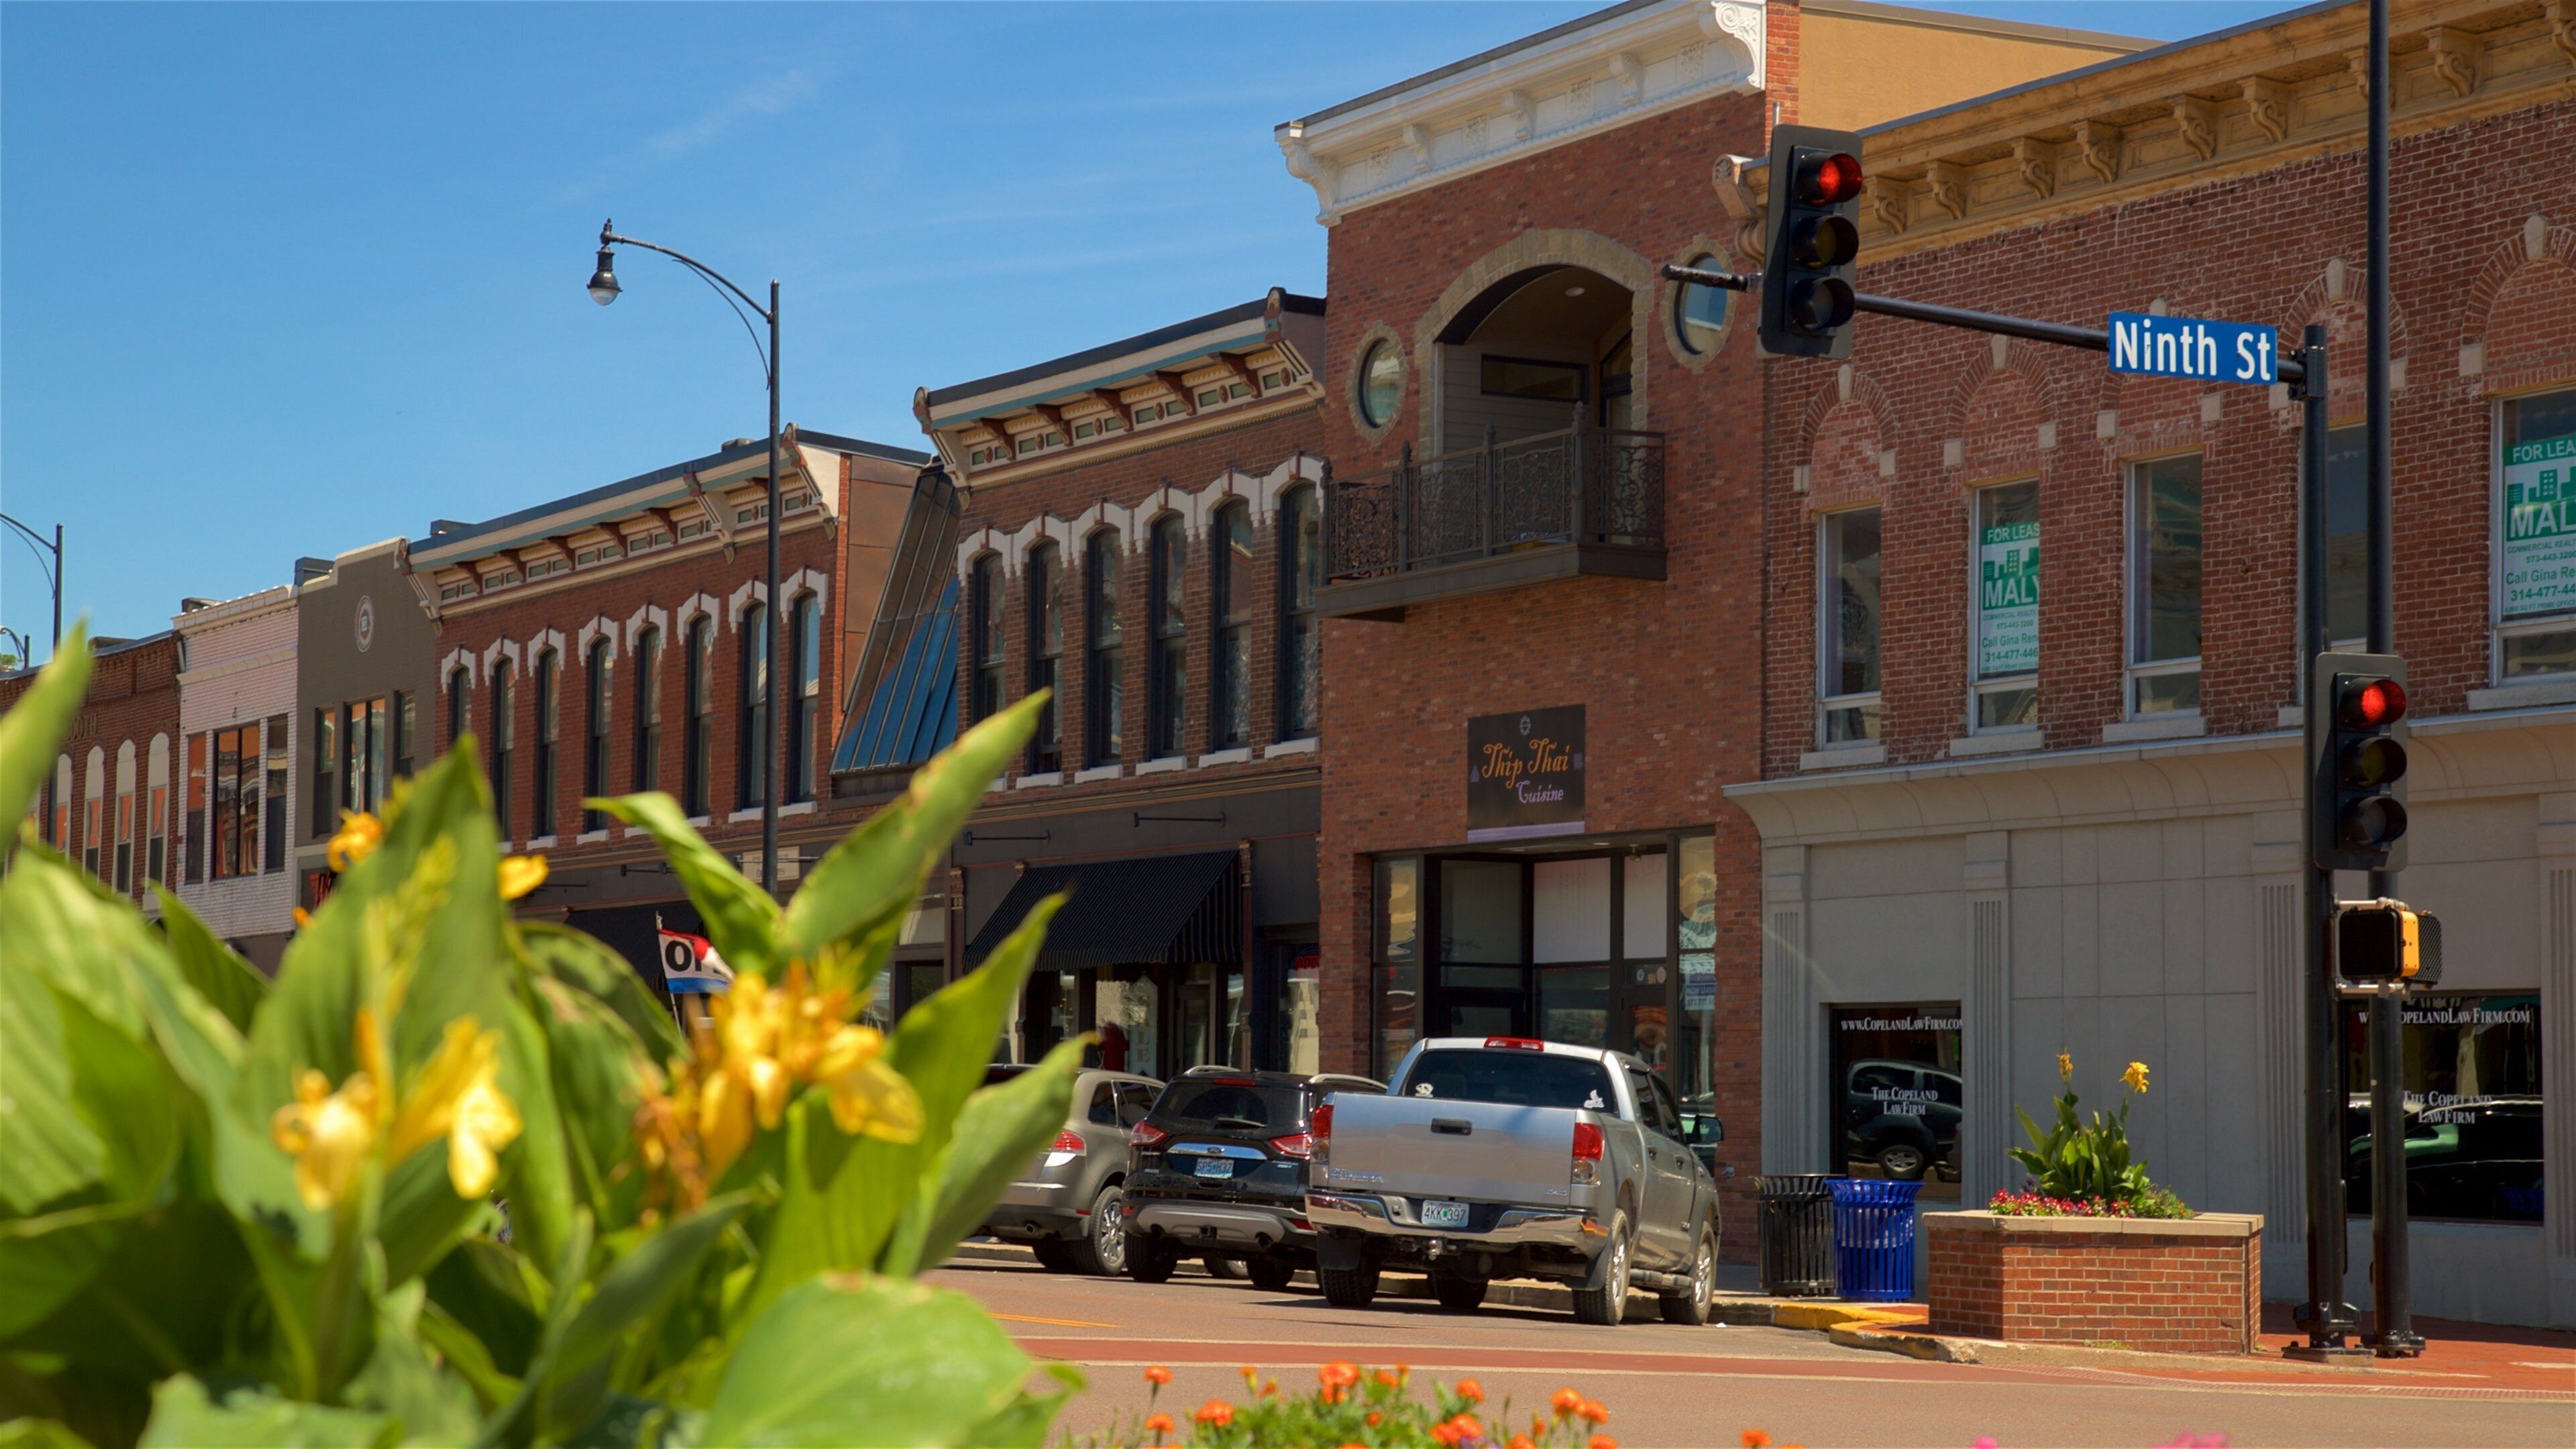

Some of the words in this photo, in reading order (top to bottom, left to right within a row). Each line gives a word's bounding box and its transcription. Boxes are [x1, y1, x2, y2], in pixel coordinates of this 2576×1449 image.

[2115, 318, 2217, 376] Ninth
[2237, 331, 2271, 381] St
[2513, 447, 2542, 462] FOR
[2547, 438, 2576, 458] LEA
[1987, 527, 2010, 543] FOR
[2508, 541, 2553, 554] COMMERCIAL
[2506, 571, 2527, 584] Call
[2531, 569, 2557, 582] Gina
[1982, 637, 1997, 648] Call
[2000, 635, 2019, 646] Gina
[1482, 743, 1523, 789] Thip
[1527, 738, 1570, 774] Thai
[1516, 780, 1564, 804] Cuisine
[1871, 1086, 1890, 1100] THE
[1891, 1087, 1939, 1101] COPELAND
[2428, 1090, 2492, 1107] COPELAND
